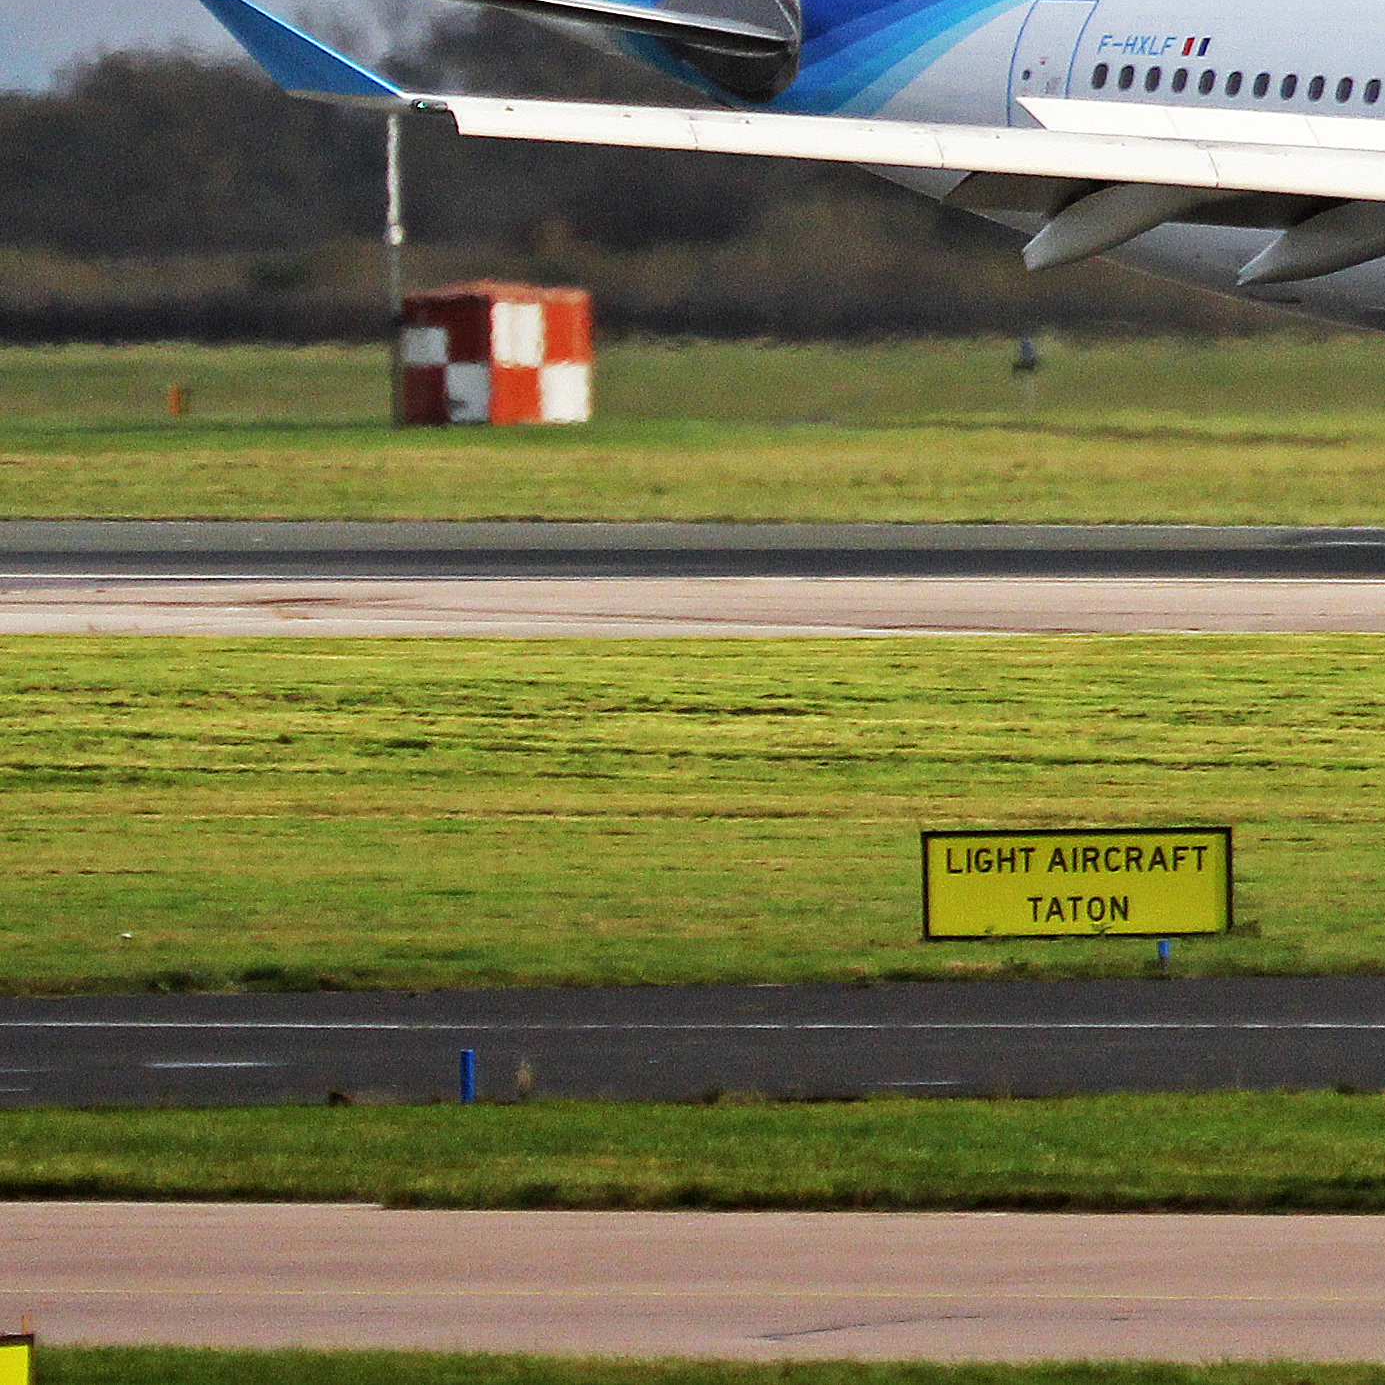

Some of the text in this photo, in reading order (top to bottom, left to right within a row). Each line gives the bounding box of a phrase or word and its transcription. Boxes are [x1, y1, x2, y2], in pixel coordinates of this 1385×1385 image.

[1097, 35, 1177, 56] F-HXLF
[945, 845, 1208, 874] LIGHT AIRCRAFT
[1026, 896, 1129, 923] TATON
